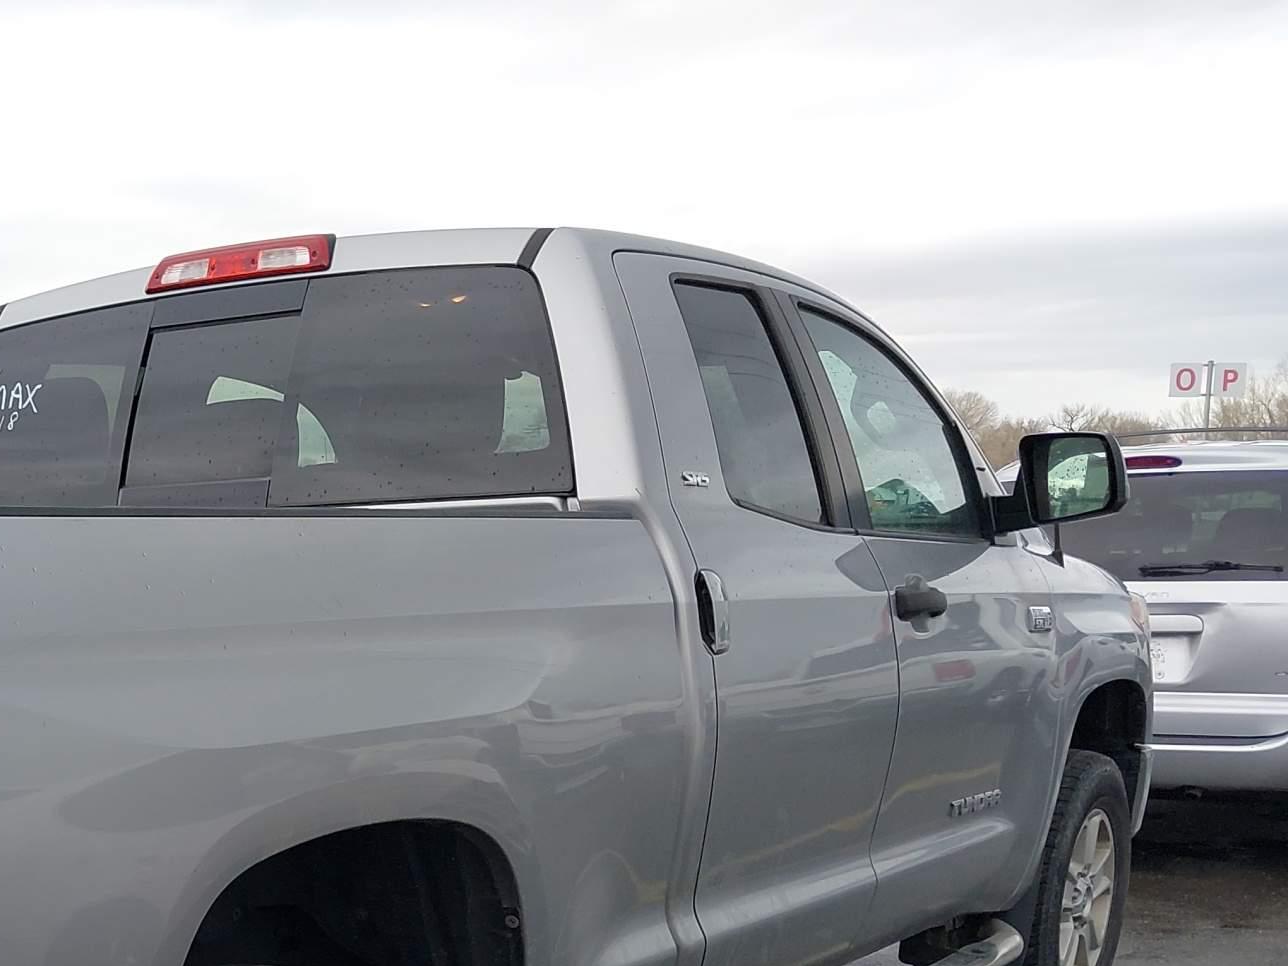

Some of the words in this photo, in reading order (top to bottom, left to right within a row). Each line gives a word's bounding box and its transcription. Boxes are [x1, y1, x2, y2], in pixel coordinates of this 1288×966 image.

[1176, 368, 1196, 391] O
[1223, 369, 1238, 391] P
[950, 788, 1001, 817] TUNDRA
